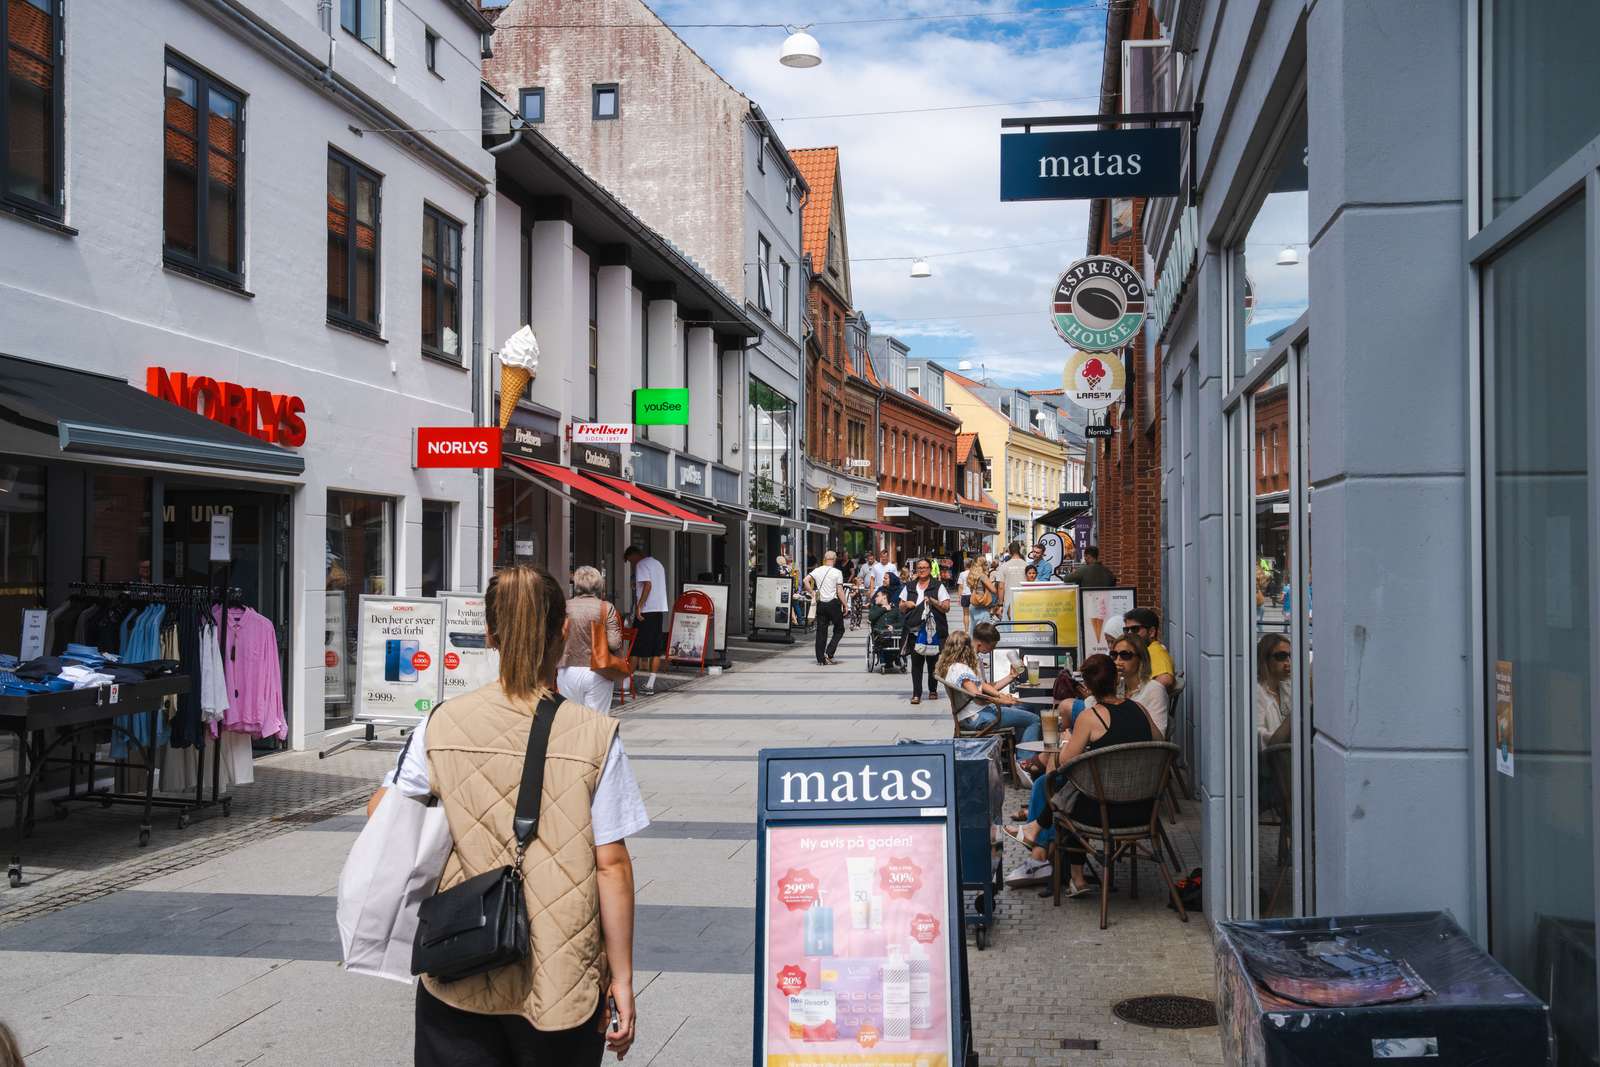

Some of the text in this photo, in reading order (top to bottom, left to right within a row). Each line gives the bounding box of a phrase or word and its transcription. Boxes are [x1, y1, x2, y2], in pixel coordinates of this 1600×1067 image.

[1039, 151, 1142, 178] matas
[1058, 262, 1140, 297] ESPRESSO
[1067, 323, 1130, 345] HOUSE
[147, 367, 307, 447] NORLYS
[644, 402, 682, 413] youSee
[578, 425, 628, 435] Frellsen
[428, 442, 489, 454] NORLYS
[371, 615, 386, 624] Den
[389, 615, 402, 625] her
[392, 626, 402, 636] gå
[404, 627, 423, 635] forbi
[367, 692, 396, 702] 2.999,-
[781, 765, 932, 803] matas
[801, 836, 913, 852] Ny avis på gaden!
[889, 872, 914, 883] 30%
[784, 976, 802, 985] 20%
[804, 999, 830, 1007] Resorb
